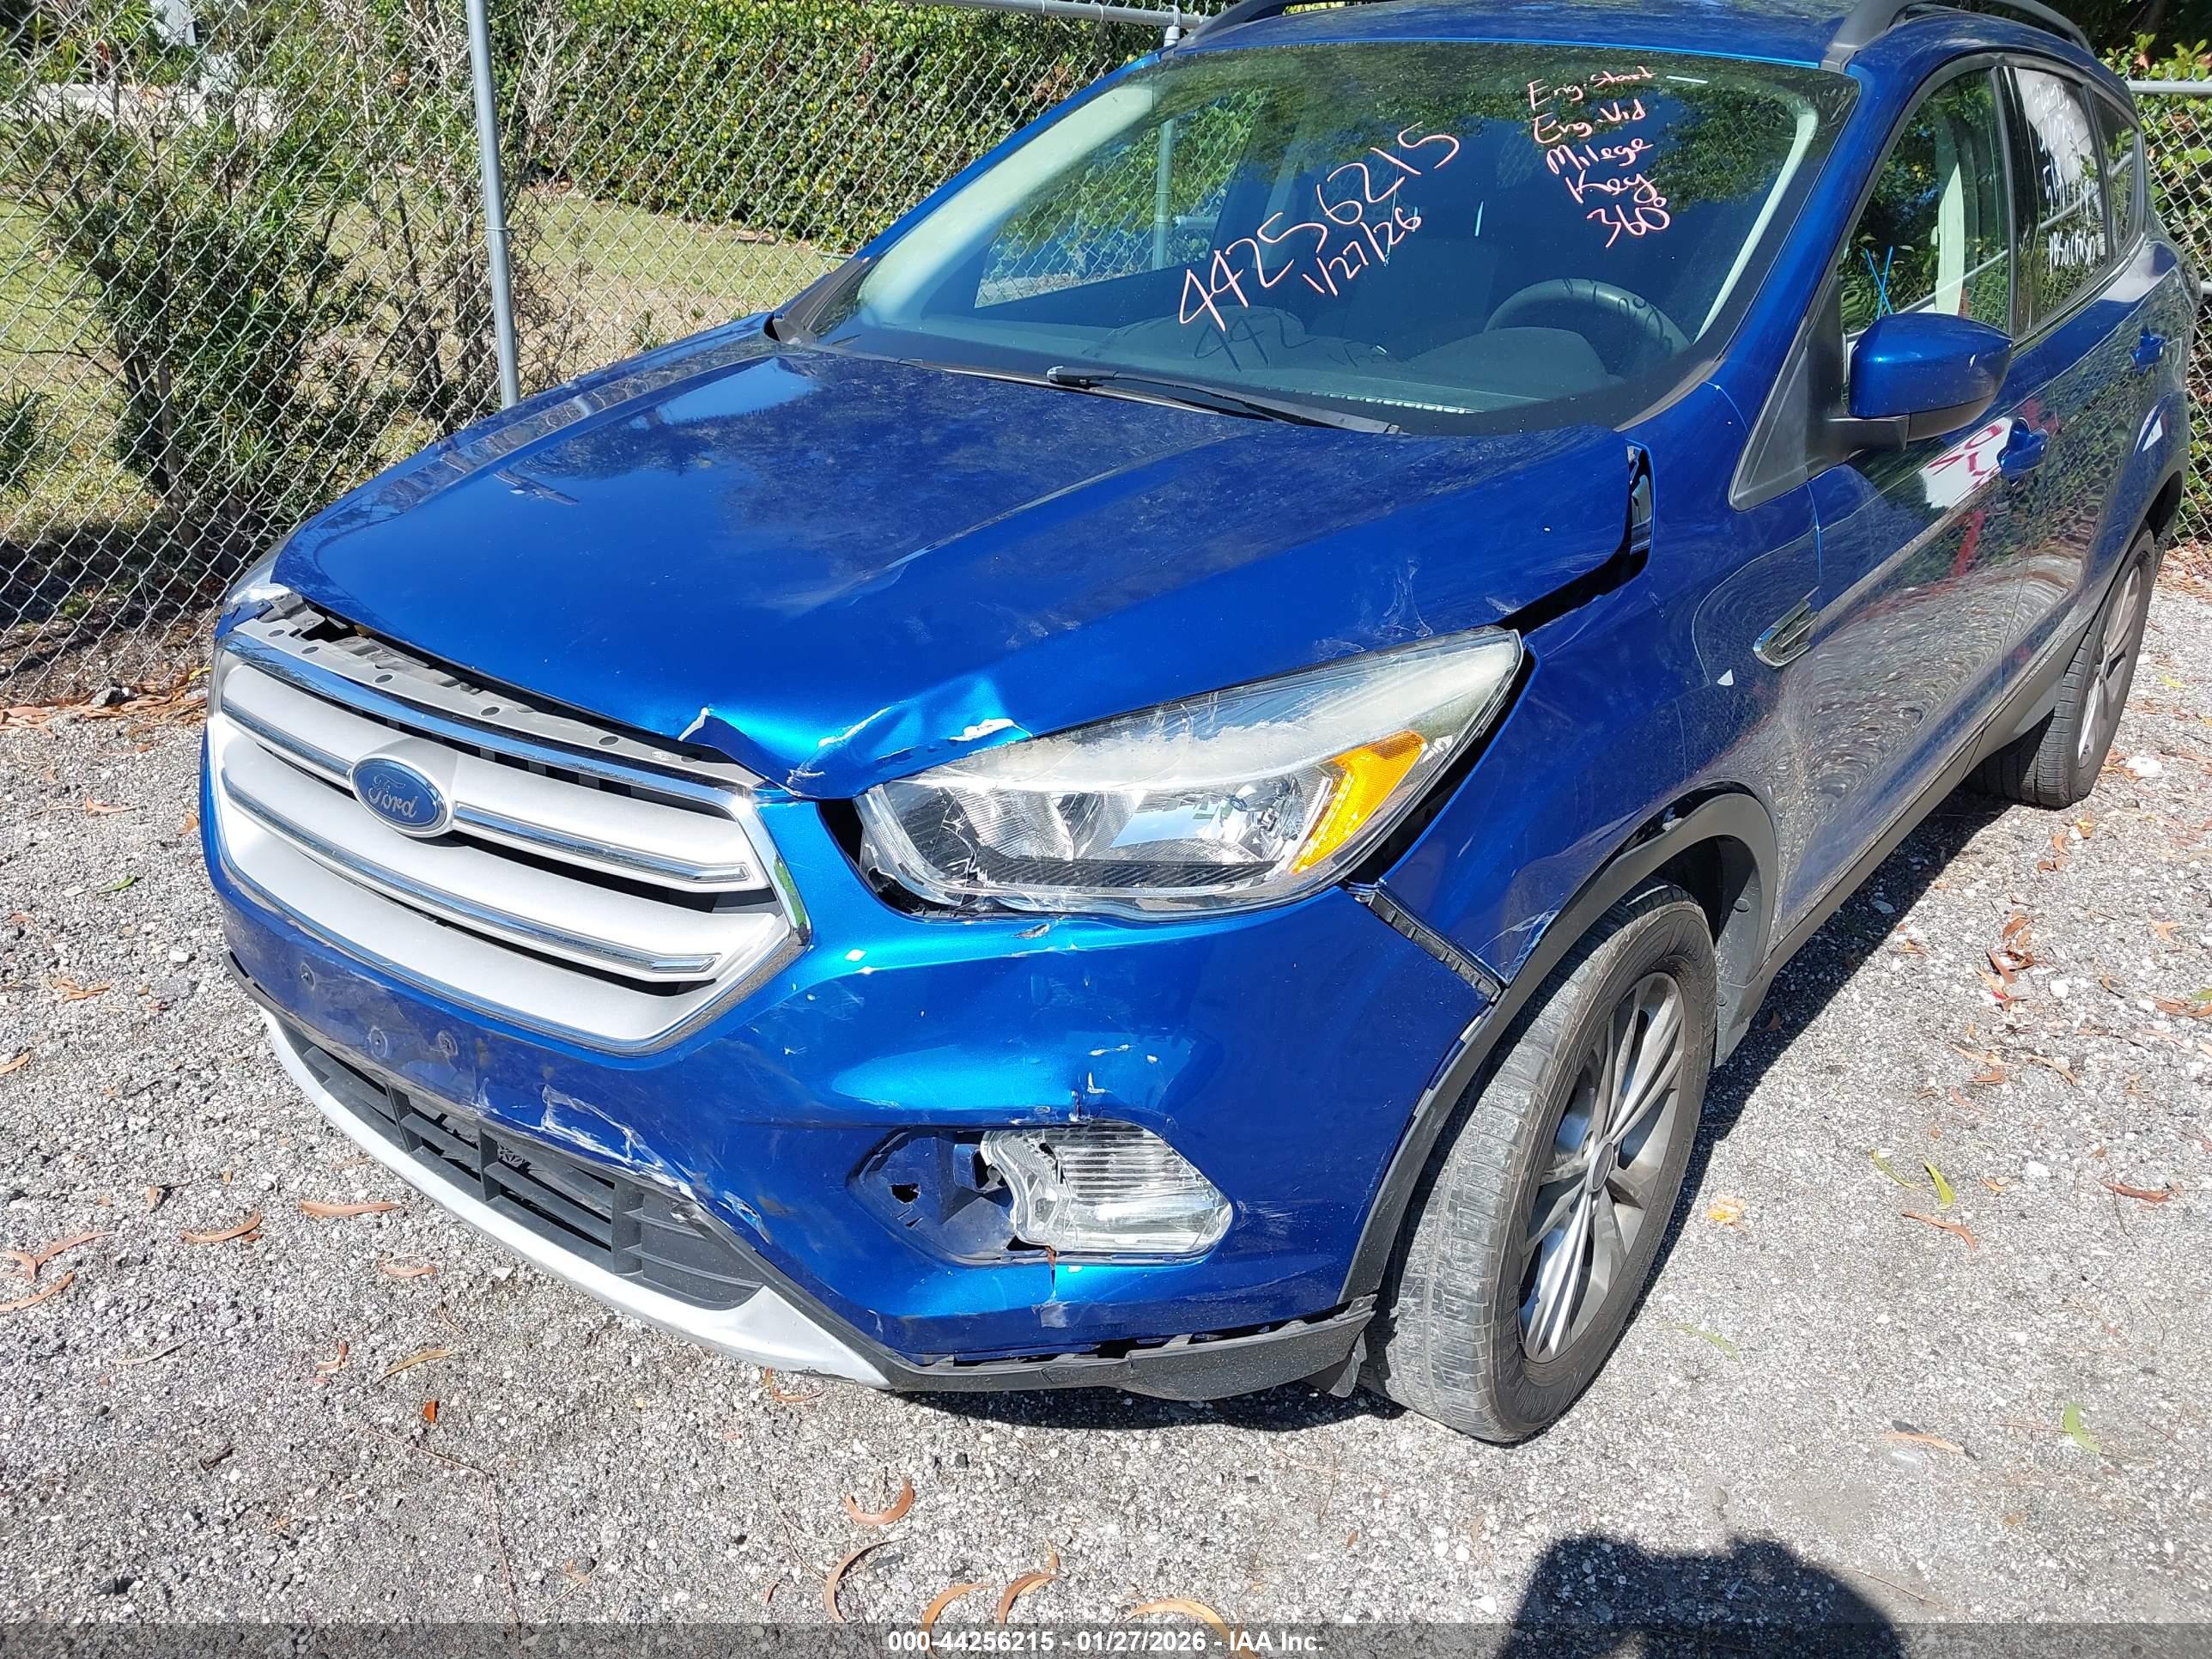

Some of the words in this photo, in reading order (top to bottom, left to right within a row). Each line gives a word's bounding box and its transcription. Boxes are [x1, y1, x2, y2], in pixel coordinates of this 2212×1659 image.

[1565, 169, 1657, 204] Key
[1179, 120, 1460, 331] 44256215
[1302, 207, 1421, 296] 1/27/26
[368, 774, 419, 818] Ford
